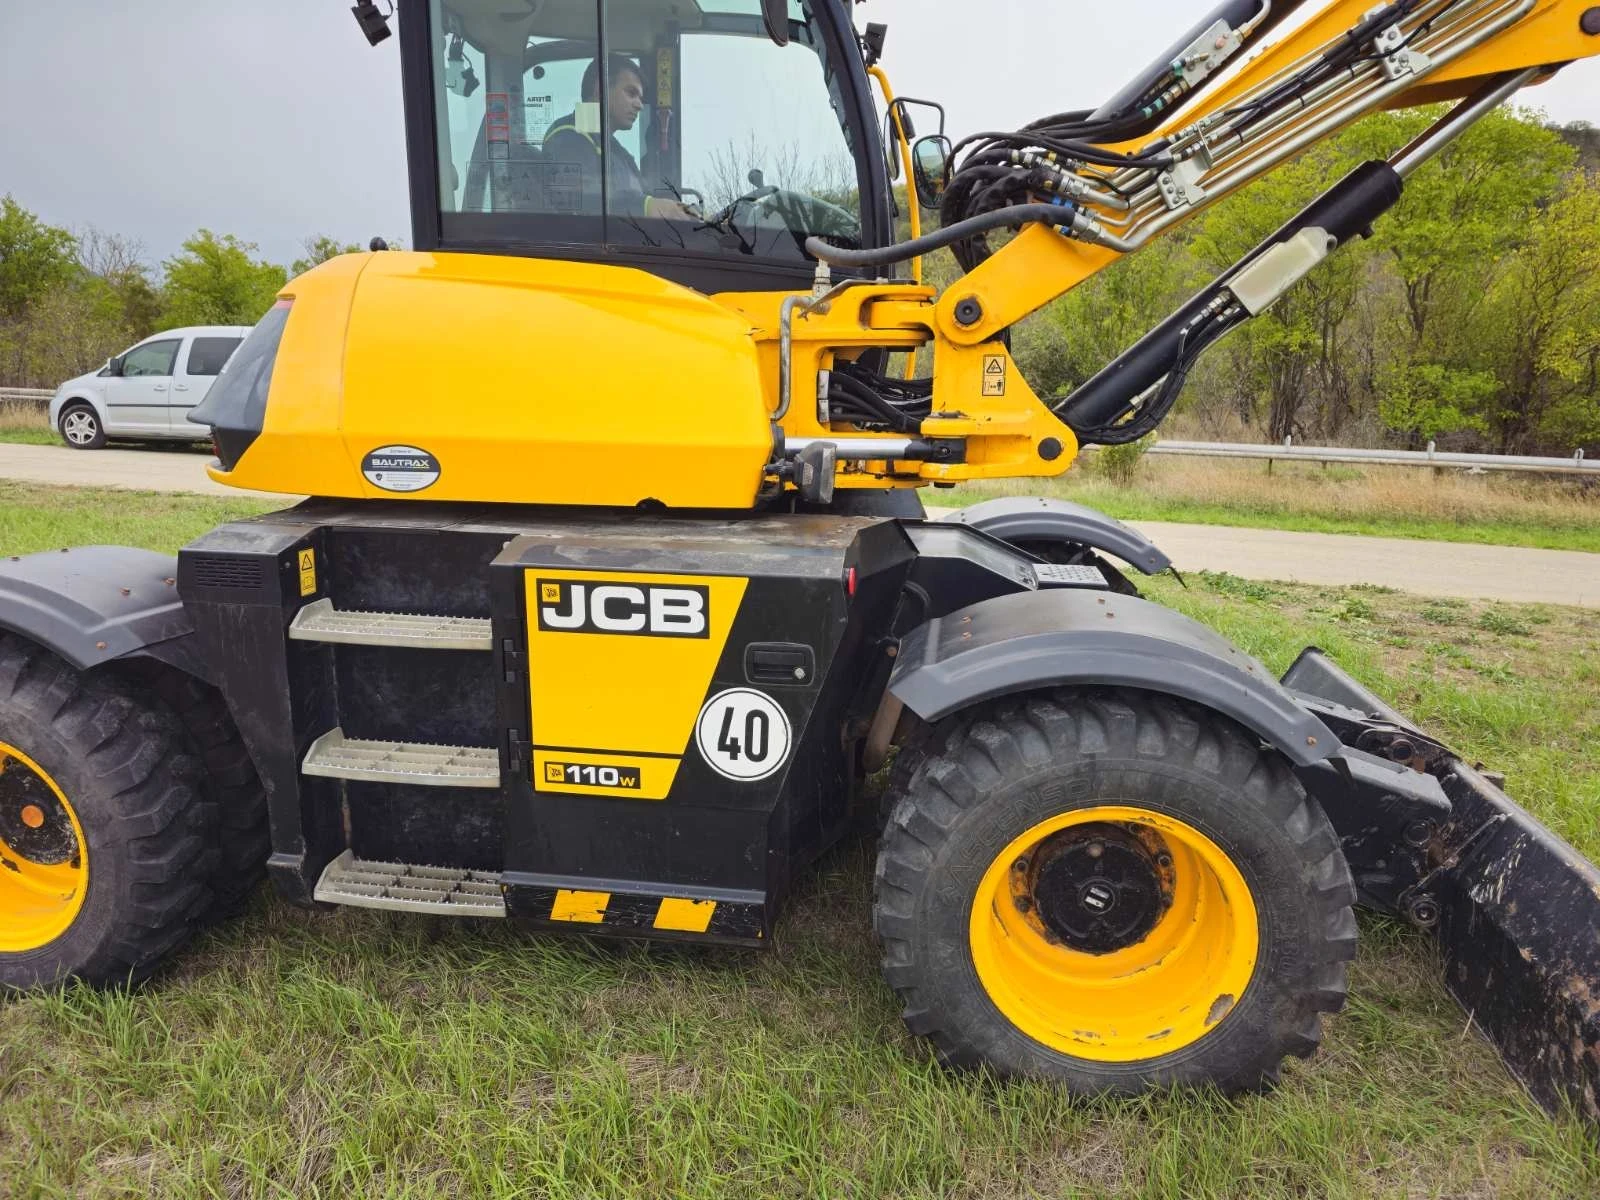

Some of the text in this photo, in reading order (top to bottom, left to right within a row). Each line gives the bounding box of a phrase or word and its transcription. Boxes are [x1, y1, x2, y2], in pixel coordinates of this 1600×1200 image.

[372, 459, 430, 467] BAUTRAX
[543, 585, 705, 633] JCB
[717, 707, 769, 762] 40
